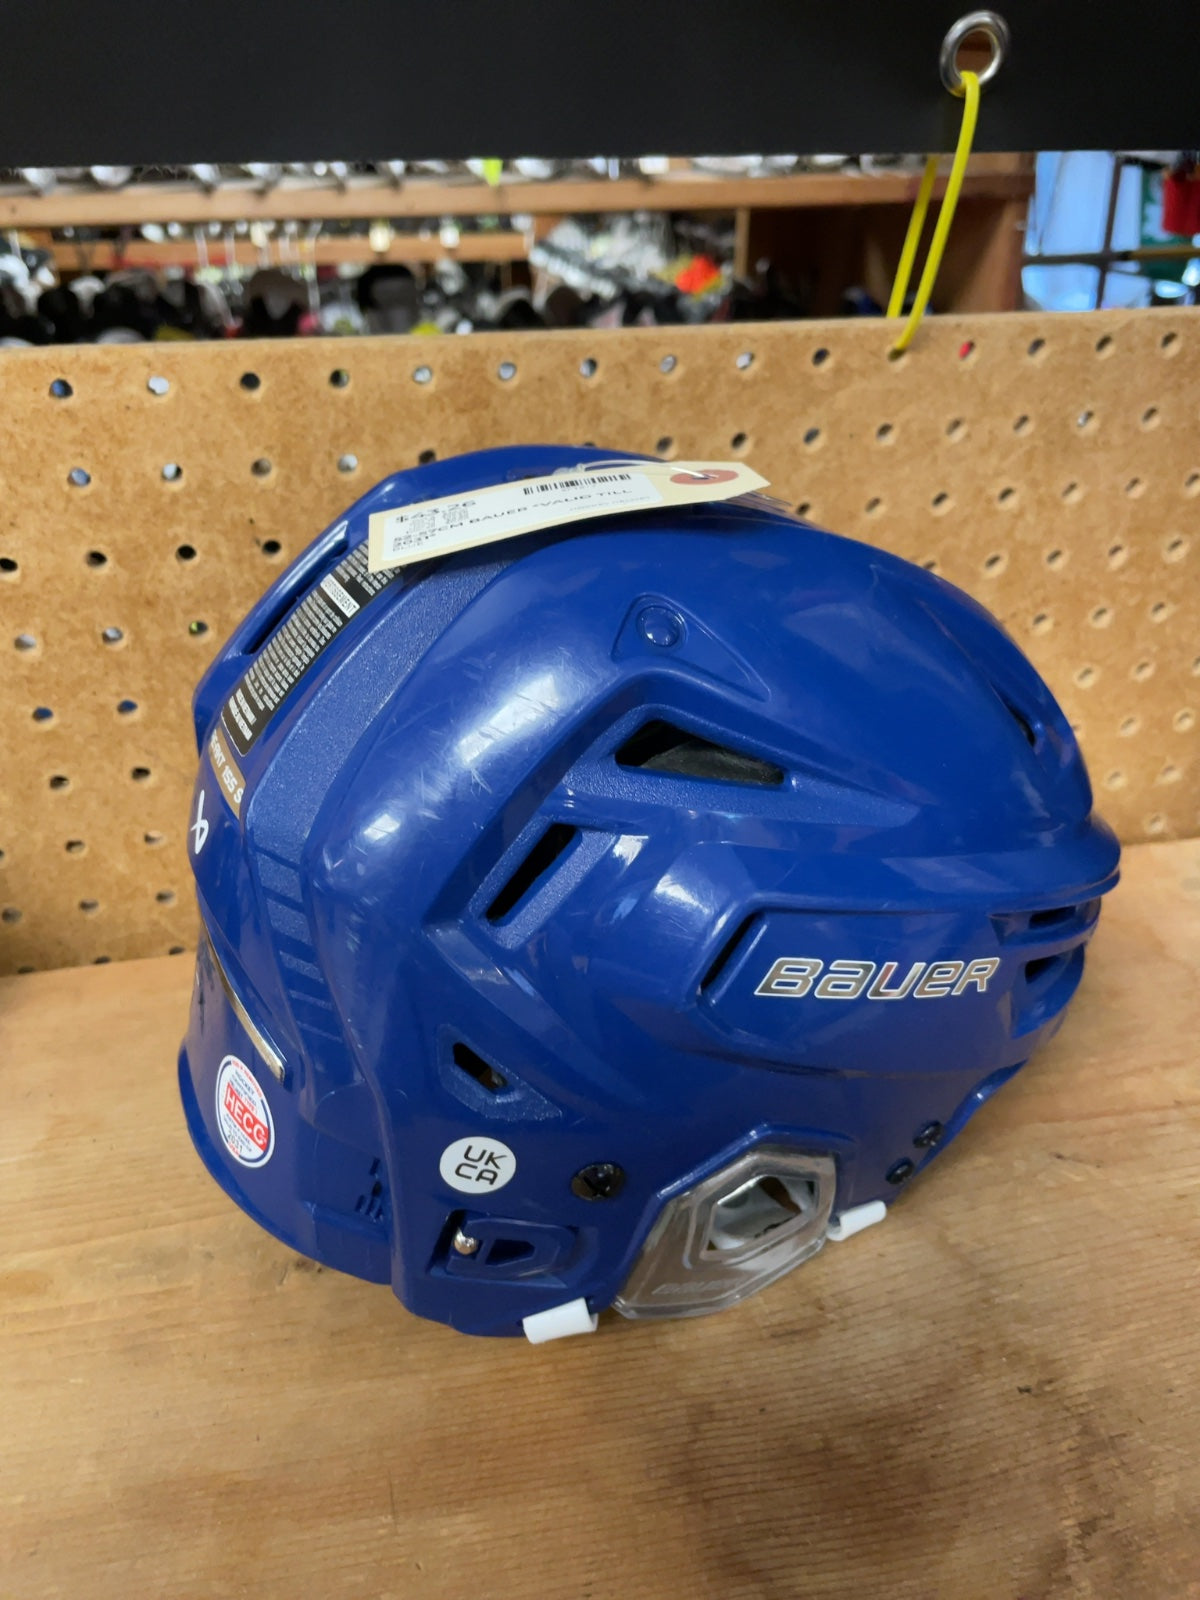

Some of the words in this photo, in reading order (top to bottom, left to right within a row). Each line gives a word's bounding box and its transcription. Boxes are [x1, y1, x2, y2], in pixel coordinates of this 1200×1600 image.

[469, 506, 528, 524] BAUER
[597, 488, 632, 497] TILL
[221, 765, 238, 793] 155
[225, 1088, 266, 1145] HECC
[464, 1145, 507, 1169] UK
[455, 1162, 498, 1186] CA
